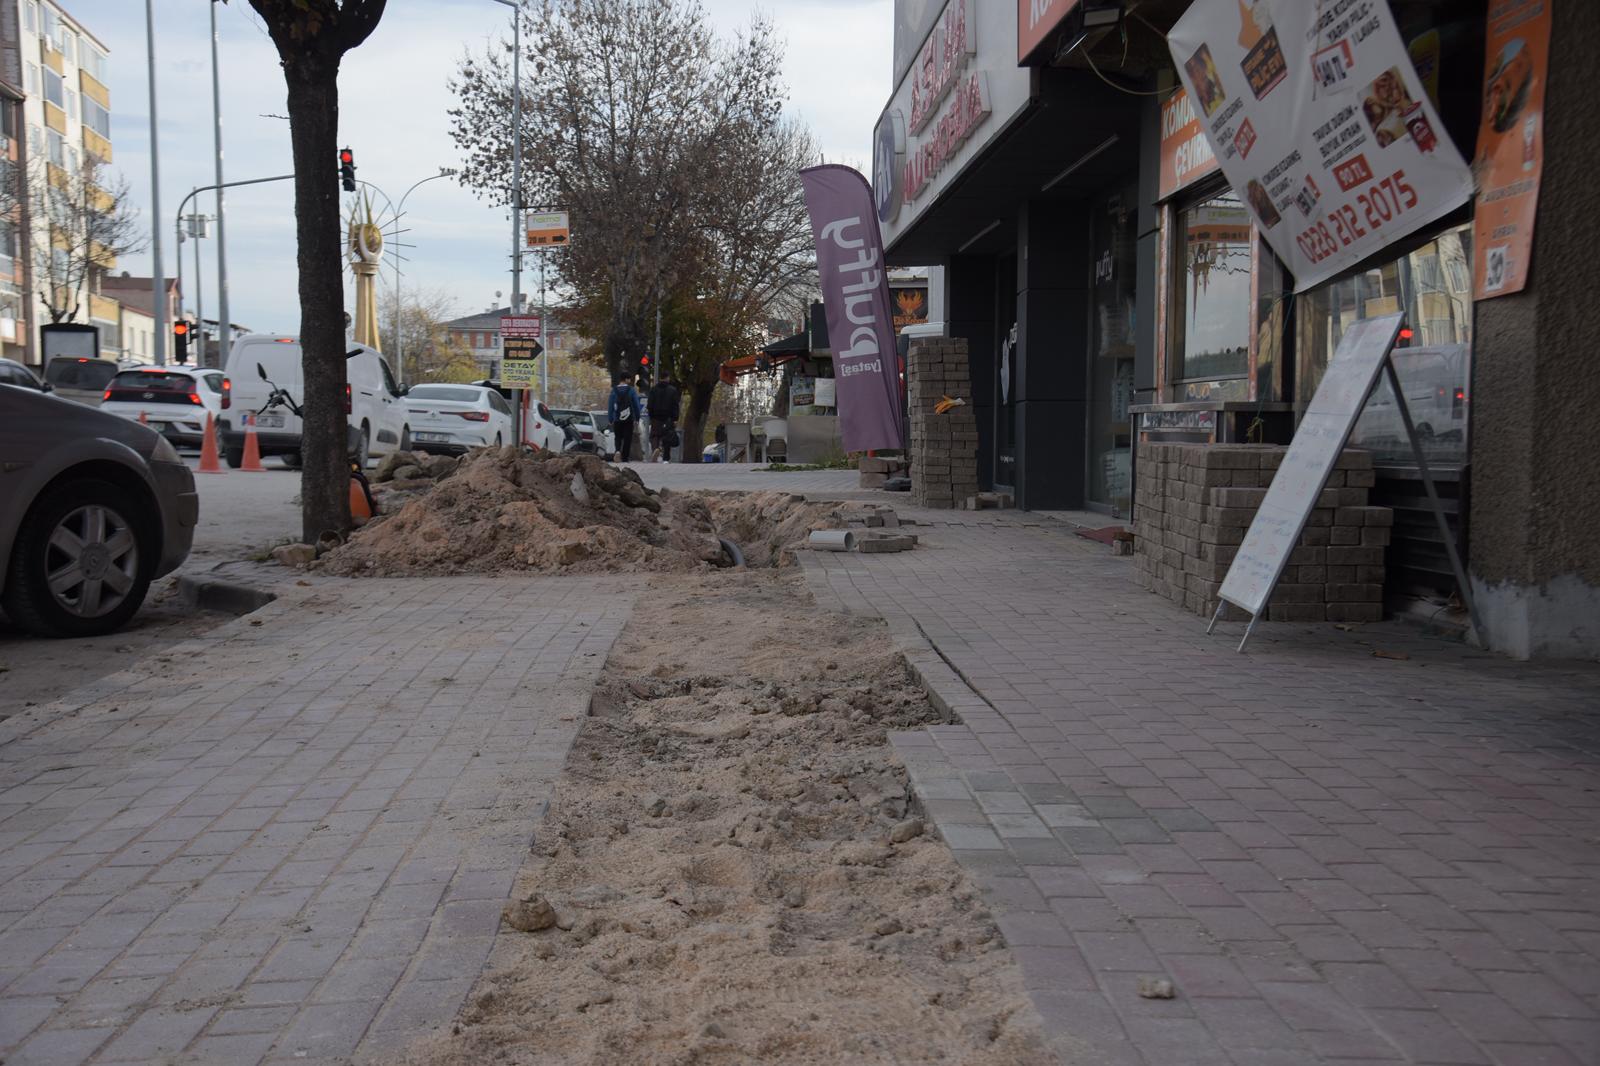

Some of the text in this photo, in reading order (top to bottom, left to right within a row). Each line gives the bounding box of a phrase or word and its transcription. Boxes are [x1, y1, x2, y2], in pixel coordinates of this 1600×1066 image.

[1296, 221, 1338, 264] 0228
[1328, 204, 1367, 247] 212
[1356, 168, 1418, 230] 2075
[1096, 249, 1113, 286] puffy
